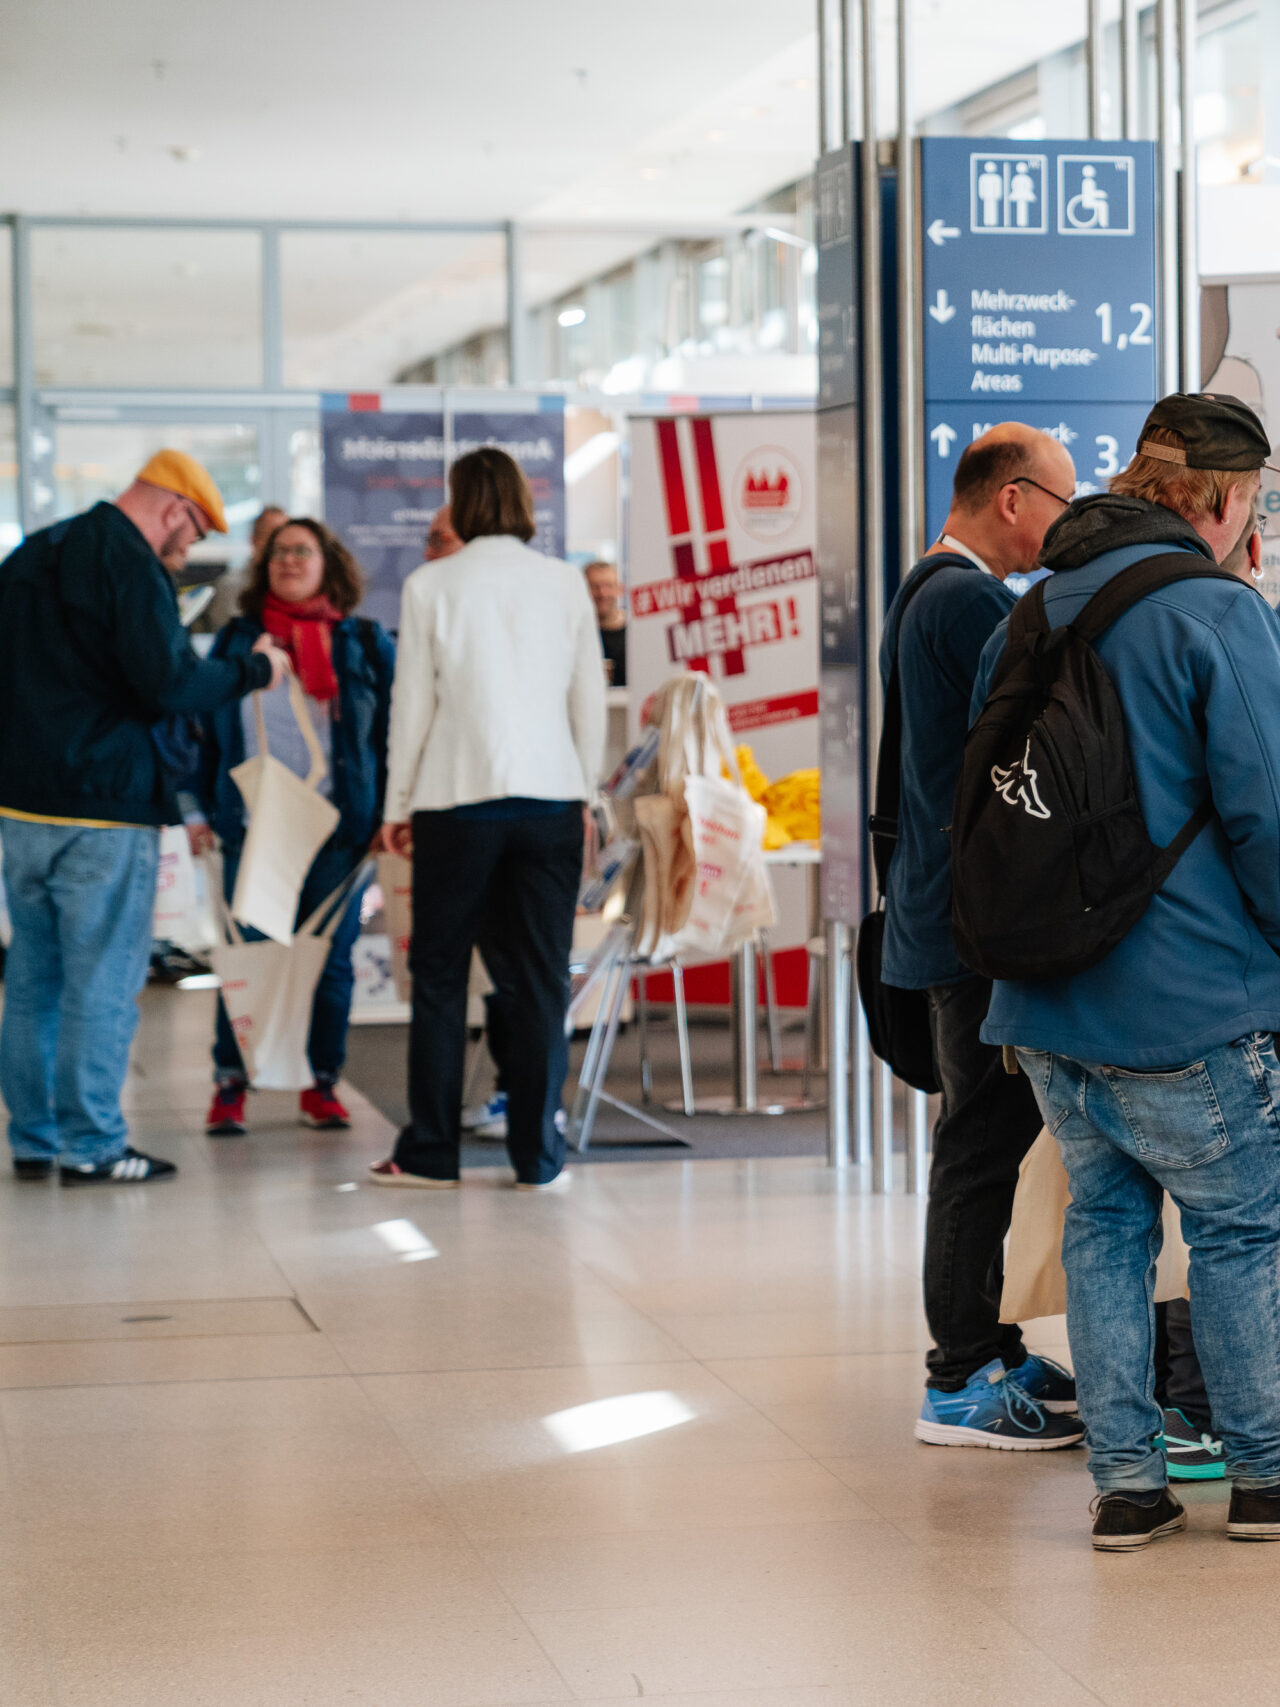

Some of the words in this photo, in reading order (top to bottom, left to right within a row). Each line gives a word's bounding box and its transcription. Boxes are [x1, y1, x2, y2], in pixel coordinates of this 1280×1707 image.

[971, 289, 1076, 312] Mehrzweck-
[1095, 302, 1153, 350] 1,2
[971, 316, 1035, 338] flächen
[971, 343, 1098, 370] Multi-Purpose-
[971, 370, 1022, 392] Areas
[695, 555, 815, 601] verdienen
